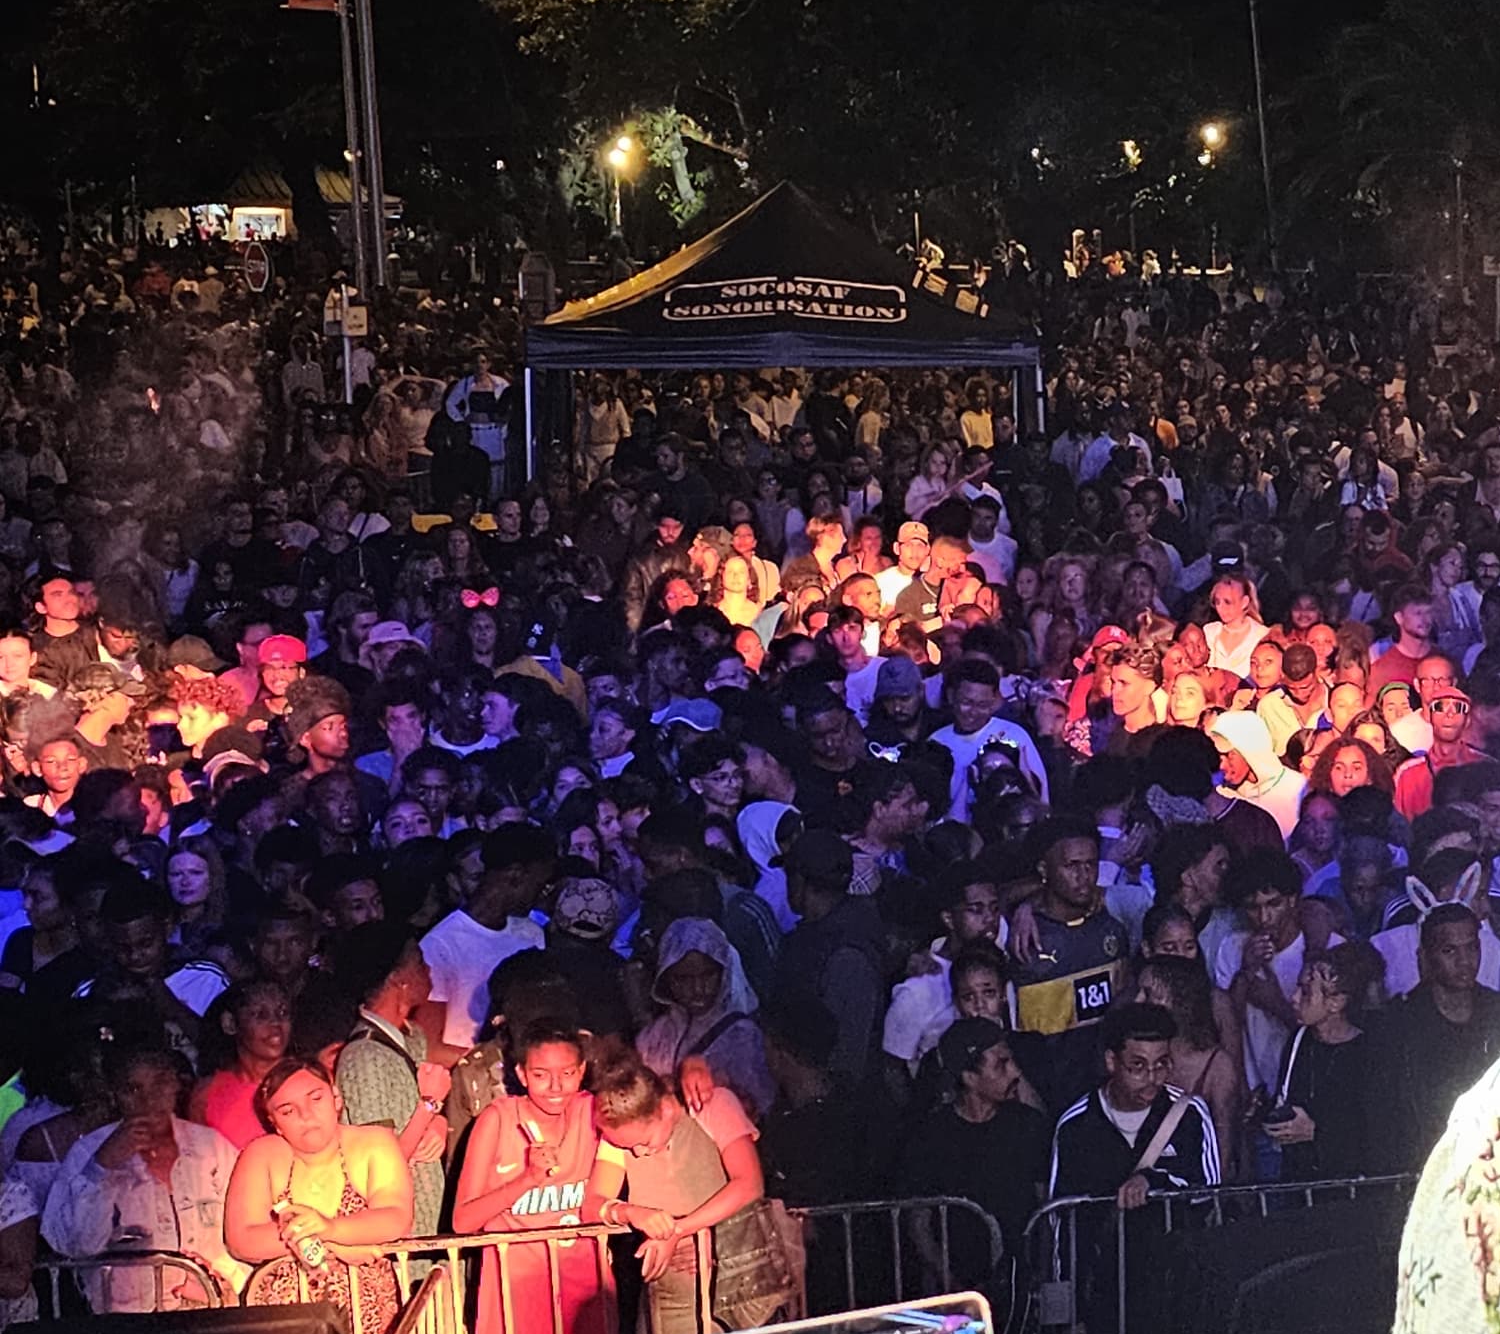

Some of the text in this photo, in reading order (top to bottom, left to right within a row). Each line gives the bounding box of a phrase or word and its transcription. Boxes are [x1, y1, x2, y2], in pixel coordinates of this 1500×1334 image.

[720, 281, 851, 299] SOCOSAF
[672, 299, 896, 318] SONORISATION
[1078, 981, 1110, 1009] 1&1
[511, 1180, 585, 1216] MIAM
